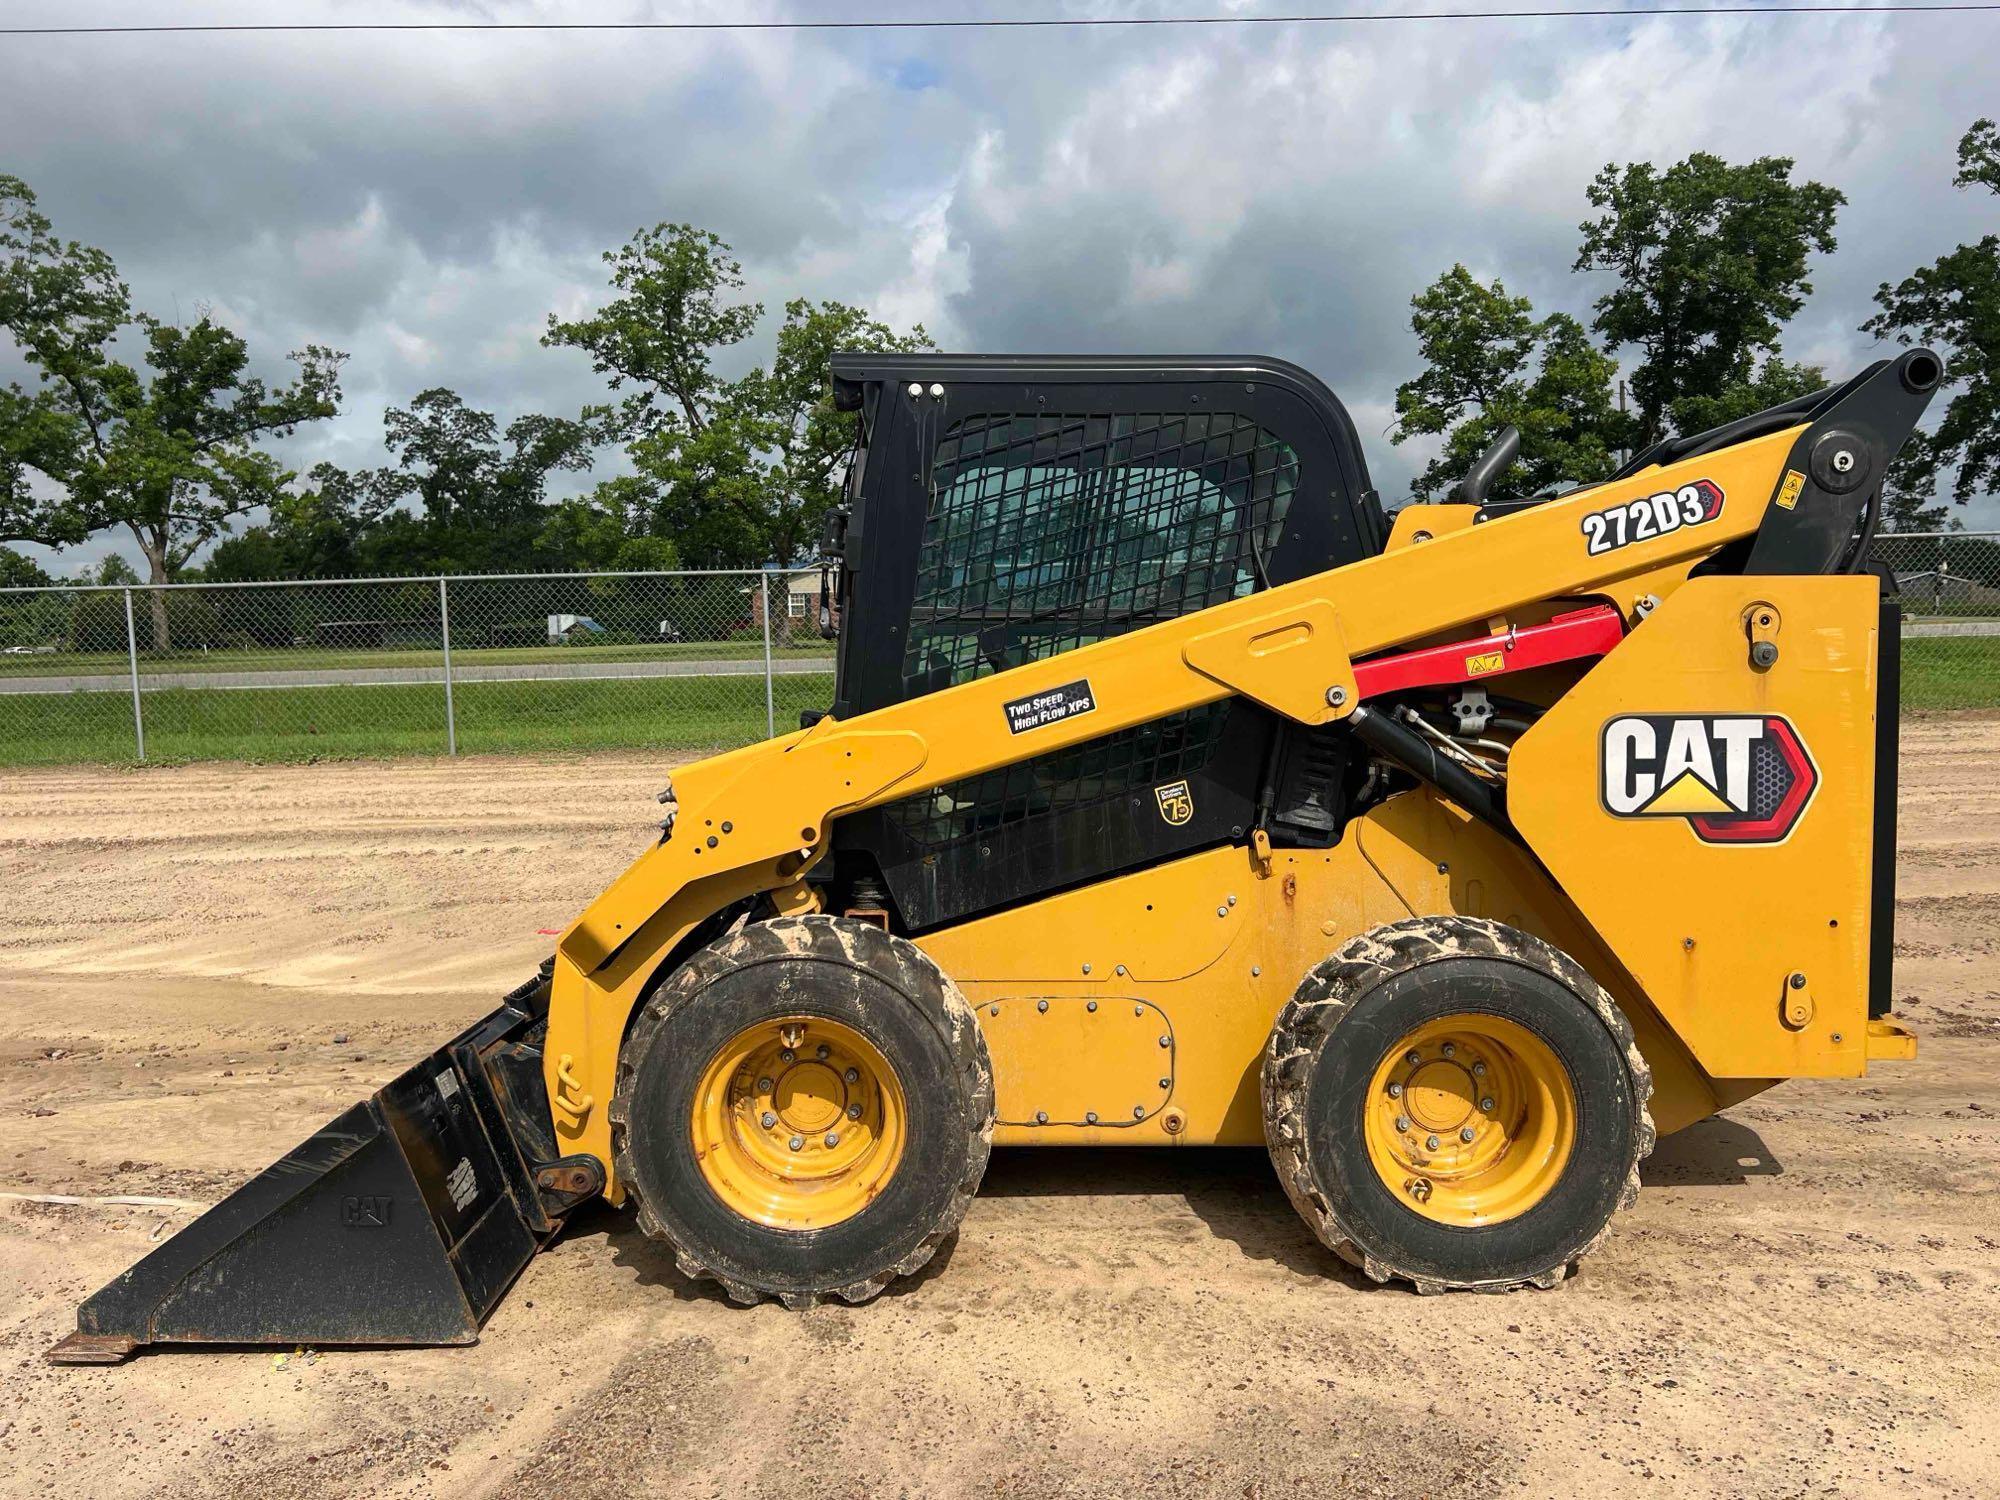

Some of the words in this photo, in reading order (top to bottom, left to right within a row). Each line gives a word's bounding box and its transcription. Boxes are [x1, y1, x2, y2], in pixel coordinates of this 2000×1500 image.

[1583, 486, 1704, 554] 272D3
[1068, 697, 1090, 714] XPS
[1605, 718, 1763, 813] CAT
[1162, 795, 1189, 820] 75
[342, 1196, 392, 1226] CAT
